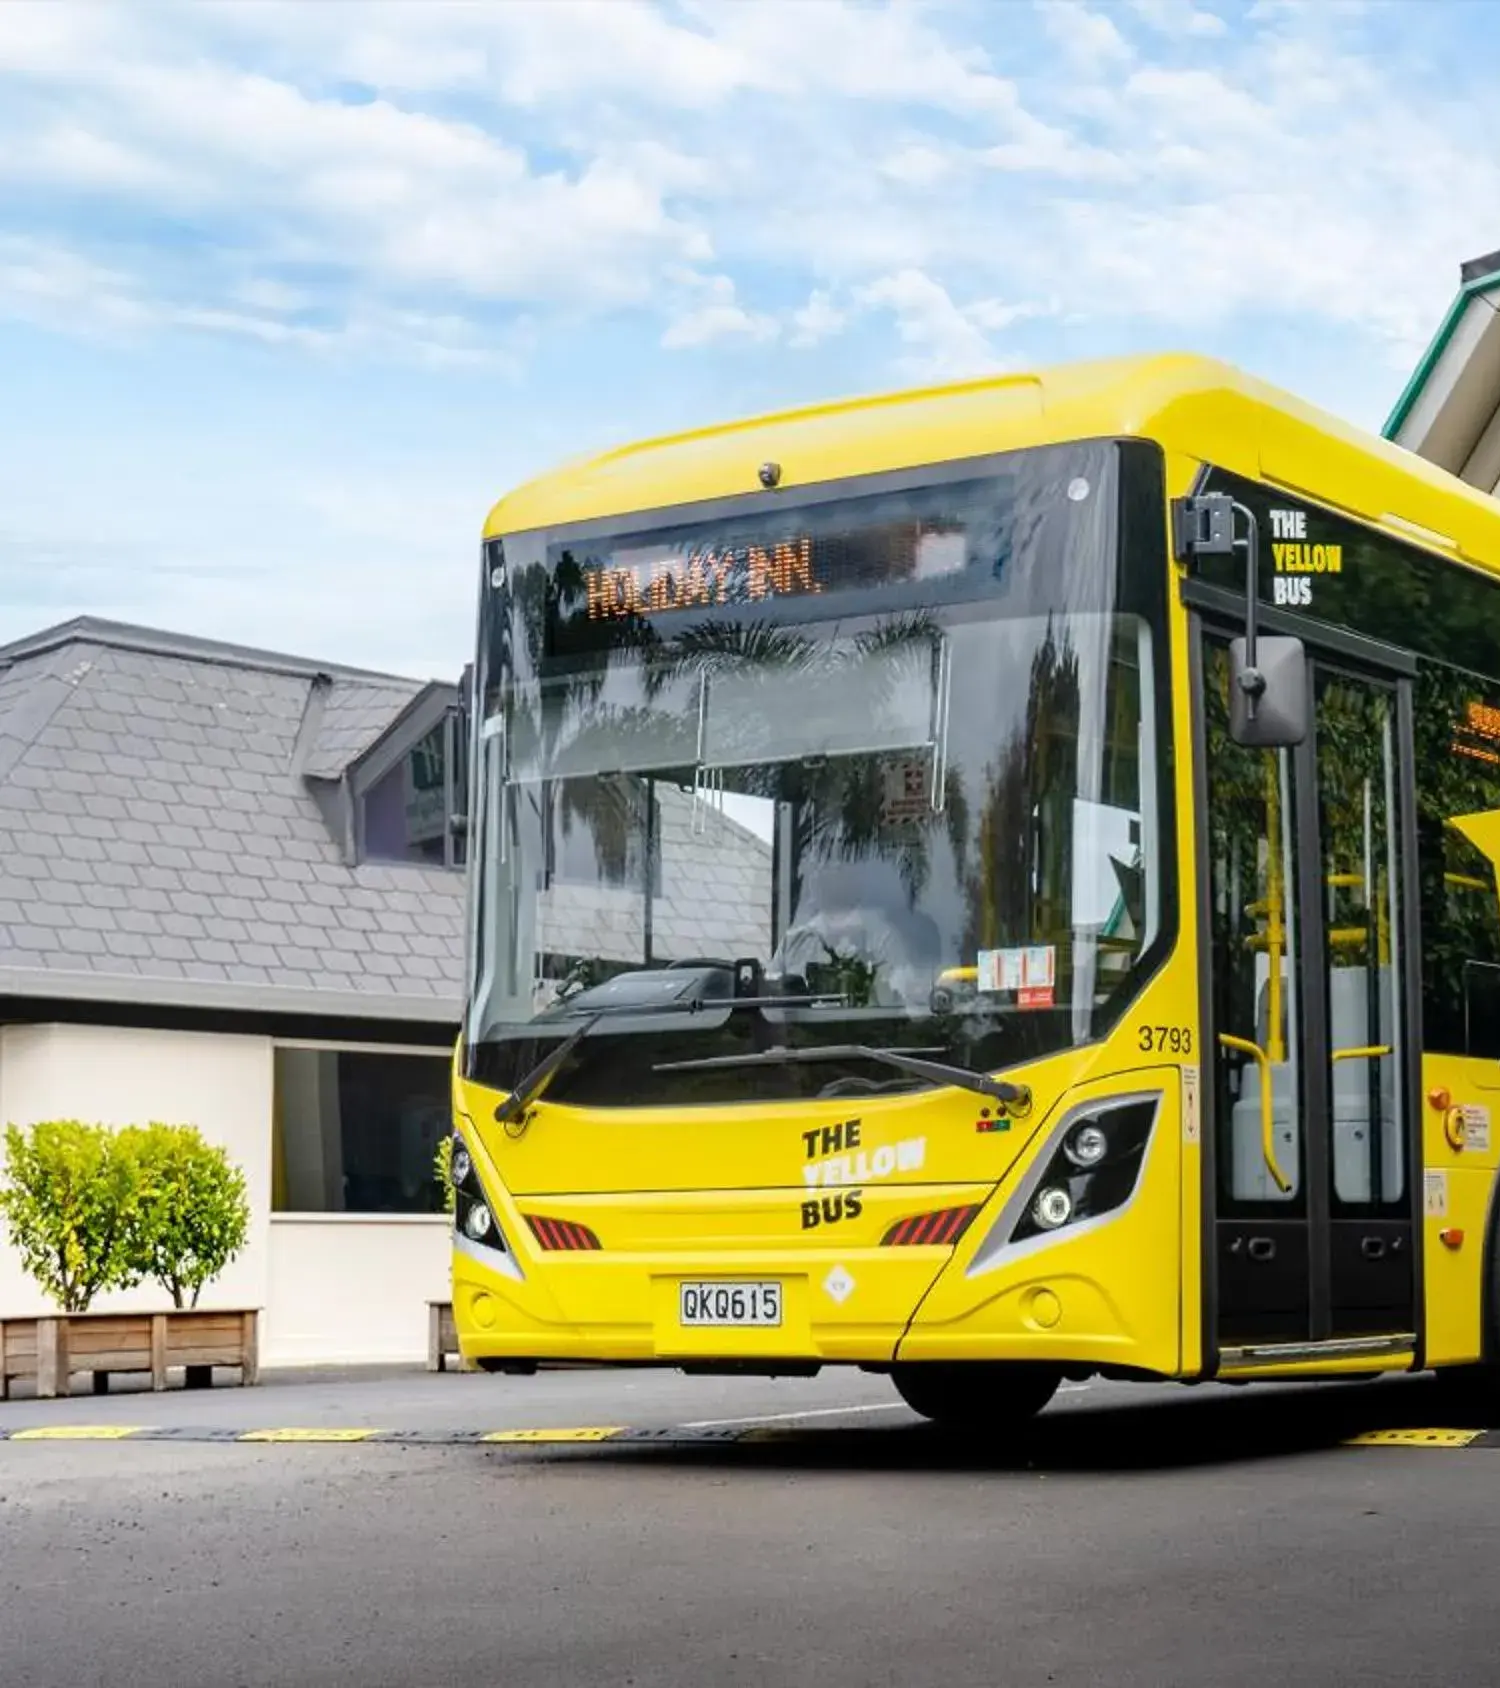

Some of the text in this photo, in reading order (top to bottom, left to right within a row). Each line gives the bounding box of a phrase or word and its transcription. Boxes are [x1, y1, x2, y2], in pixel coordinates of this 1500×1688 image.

[1269, 509, 1307, 538] THE
[1272, 543, 1342, 573] YELLOW
[1273, 576, 1312, 605] BUS
[1138, 1025, 1192, 1055] 3793
[802, 1118, 861, 1158] THE
[802, 1136, 927, 1197] YELLOW
[801, 1190, 862, 1230] BUS
[684, 1288, 778, 1320] QKQ615
